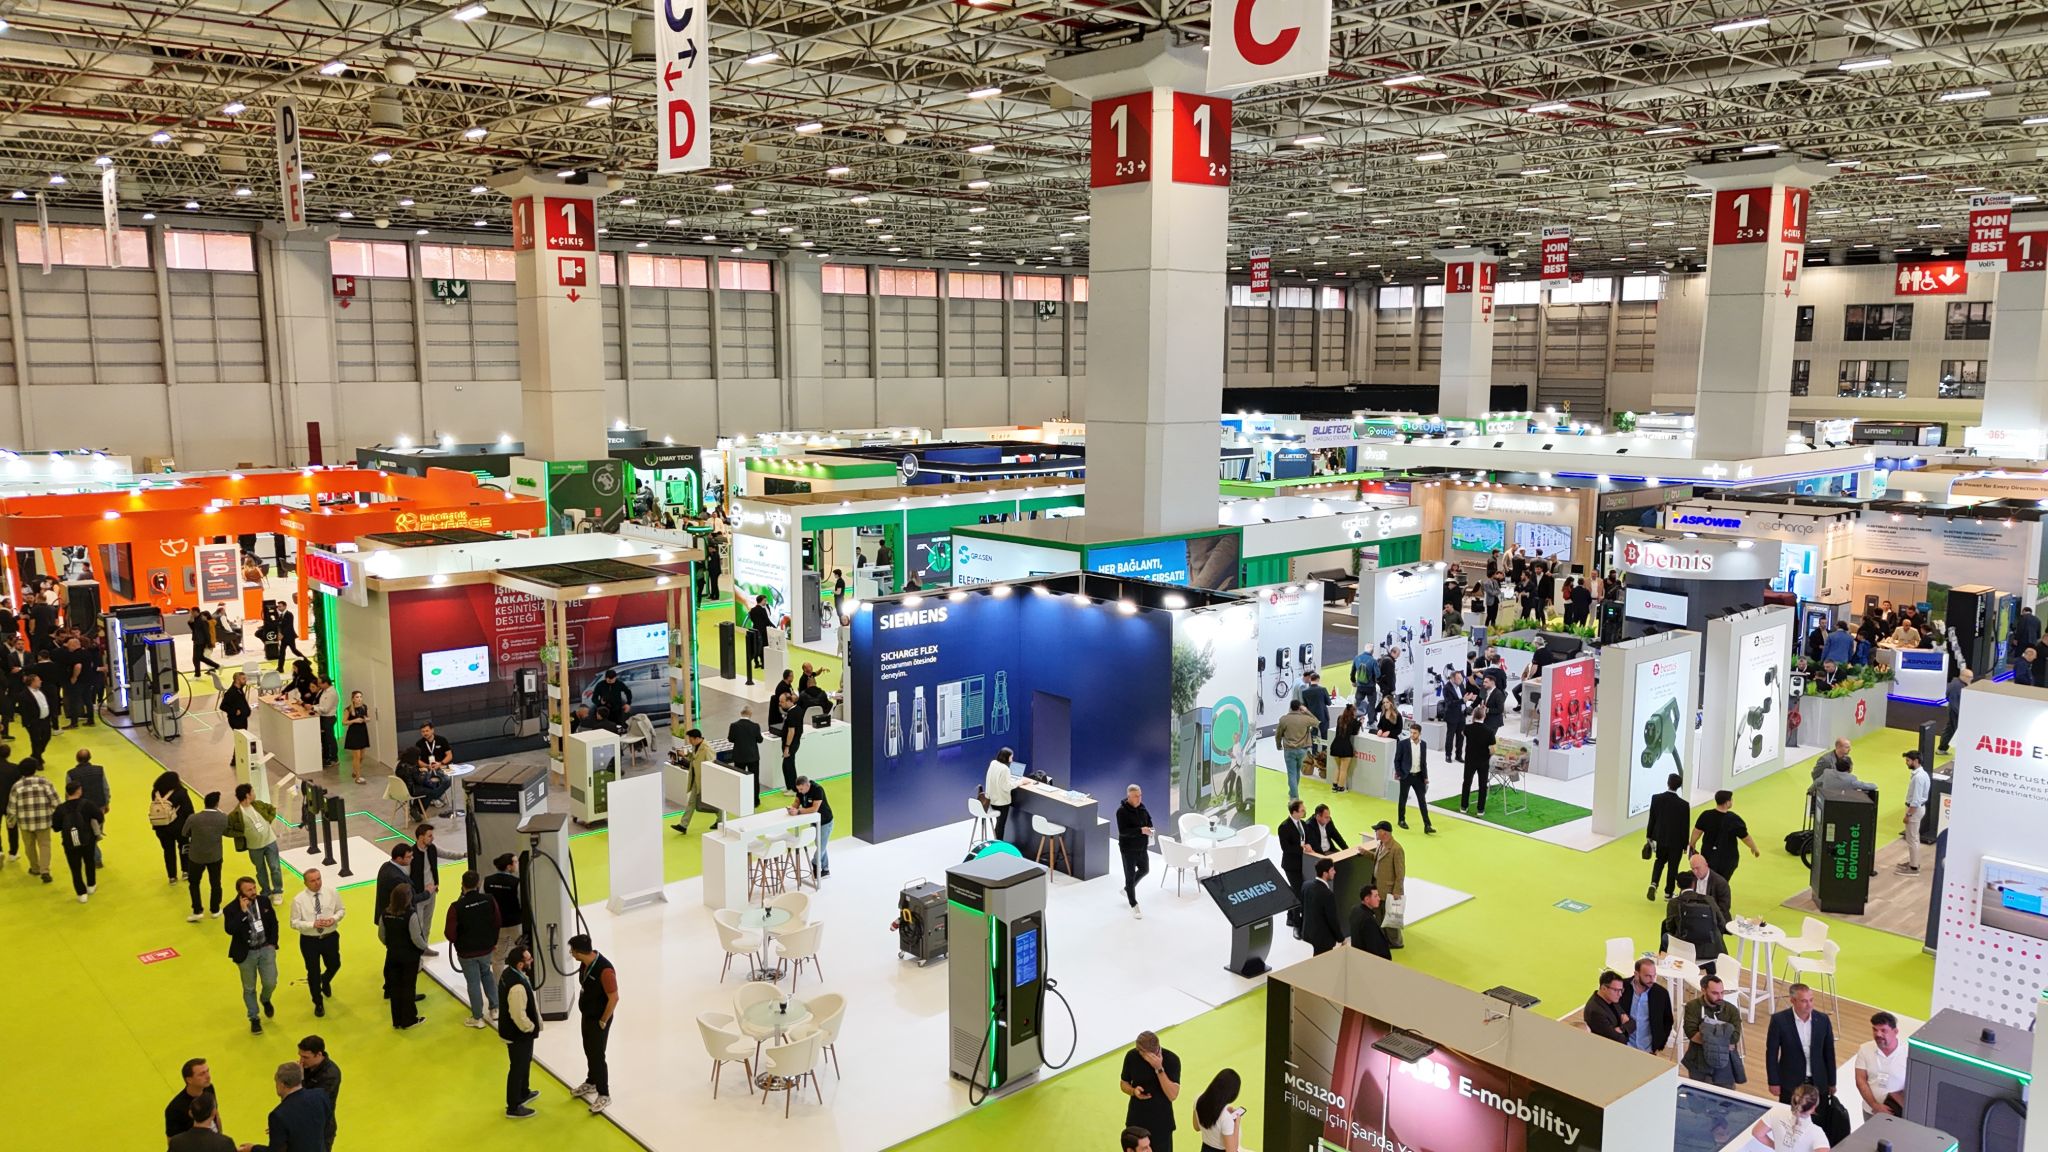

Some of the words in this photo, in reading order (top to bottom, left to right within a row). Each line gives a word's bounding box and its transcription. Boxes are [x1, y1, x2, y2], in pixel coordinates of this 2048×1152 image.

[1233, 0, 1301, 66] C
[282, 105, 294, 145] D
[668, 99, 696, 159] D
[1110, 104, 1128, 158] 1
[1193, 103, 1211, 158] 1
[1115, 160, 1135, 177] 2-3
[1209, 162, 1216, 177] 2
[289, 184, 300, 222] E
[1733, 194, 1750, 227] 1
[1792, 193, 1801, 227] 1
[519, 203, 526, 234] 1
[561, 203, 577, 235] 1
[1972, 215, 2008, 227] JOIN
[558, 237, 584, 247] ÇIKIŞ
[1736, 229, 1754, 239] 2-3
[1975, 228, 2003, 240] THE
[1544, 243, 1568, 253] JOIN
[1970, 240, 2006, 253] BEST
[2017, 235, 2032, 260] 1
[1252, 262, 1270, 270] JOIN
[1546, 253, 1565, 263] THE
[1253, 270, 1268, 279] THE
[1455, 265, 1464, 285] 1
[1485, 265, 1492, 285] 1
[1543, 263, 1568, 274] BEST
[1251, 279, 1269, 288] BEST
[1312, 425, 1352, 436] BLUETECH
[1410, 421, 1445, 435] otojet
[608, 436, 625, 444] TECH
[1679, 514, 1742, 529] ASPOWER
[1757, 520, 1814, 536] ascharge
[1098, 564, 1116, 575] HER
[1117, 558, 1163, 573] BAĞLANTI,
[1644, 546, 1712, 570] bemis
[304, 554, 345, 588] VESTEL
[1872, 567, 1919, 578] ASPOWER
[495, 602, 546, 616] KESİNTİSİZ
[1651, 602, 1667, 611] bemis
[495, 613, 536, 626] DESTEĞİ
[880, 606, 948, 630] SIEMENS
[880, 647, 919, 662] SICHARGE
[920, 645, 939, 655] FLEX
[880, 661, 913, 672] Donanımın
[913, 656, 937, 666] ötesinde
[880, 670, 908, 681] deneyim.
[1975, 735, 2023, 757] ABB
[1355, 750, 1377, 763] emis
[1973, 765, 2009, 779] Same
[1972, 776, 1995, 784] with
[1996, 780, 2016, 788] new
[2019, 784, 2042, 793] Ares
[1972, 783, 1994, 792] from
[1994, 788, 2048, 801] destination
[1849, 823, 1861, 838] et.
[1834, 840, 1848, 856] et,
[1833, 857, 1849, 879] sarj
[1846, 839, 1860, 880] devam
[1227, 880, 1277, 905] SIEMENS
[1284, 1072, 1346, 1110] MCS1200
[1458, 1075, 1581, 1146] E-mobility
[1284, 1090, 1323, 1118] Filolar
[1325, 1106, 1348, 1131] İçin
[1350, 1122, 1394, 1152] Şarjda
